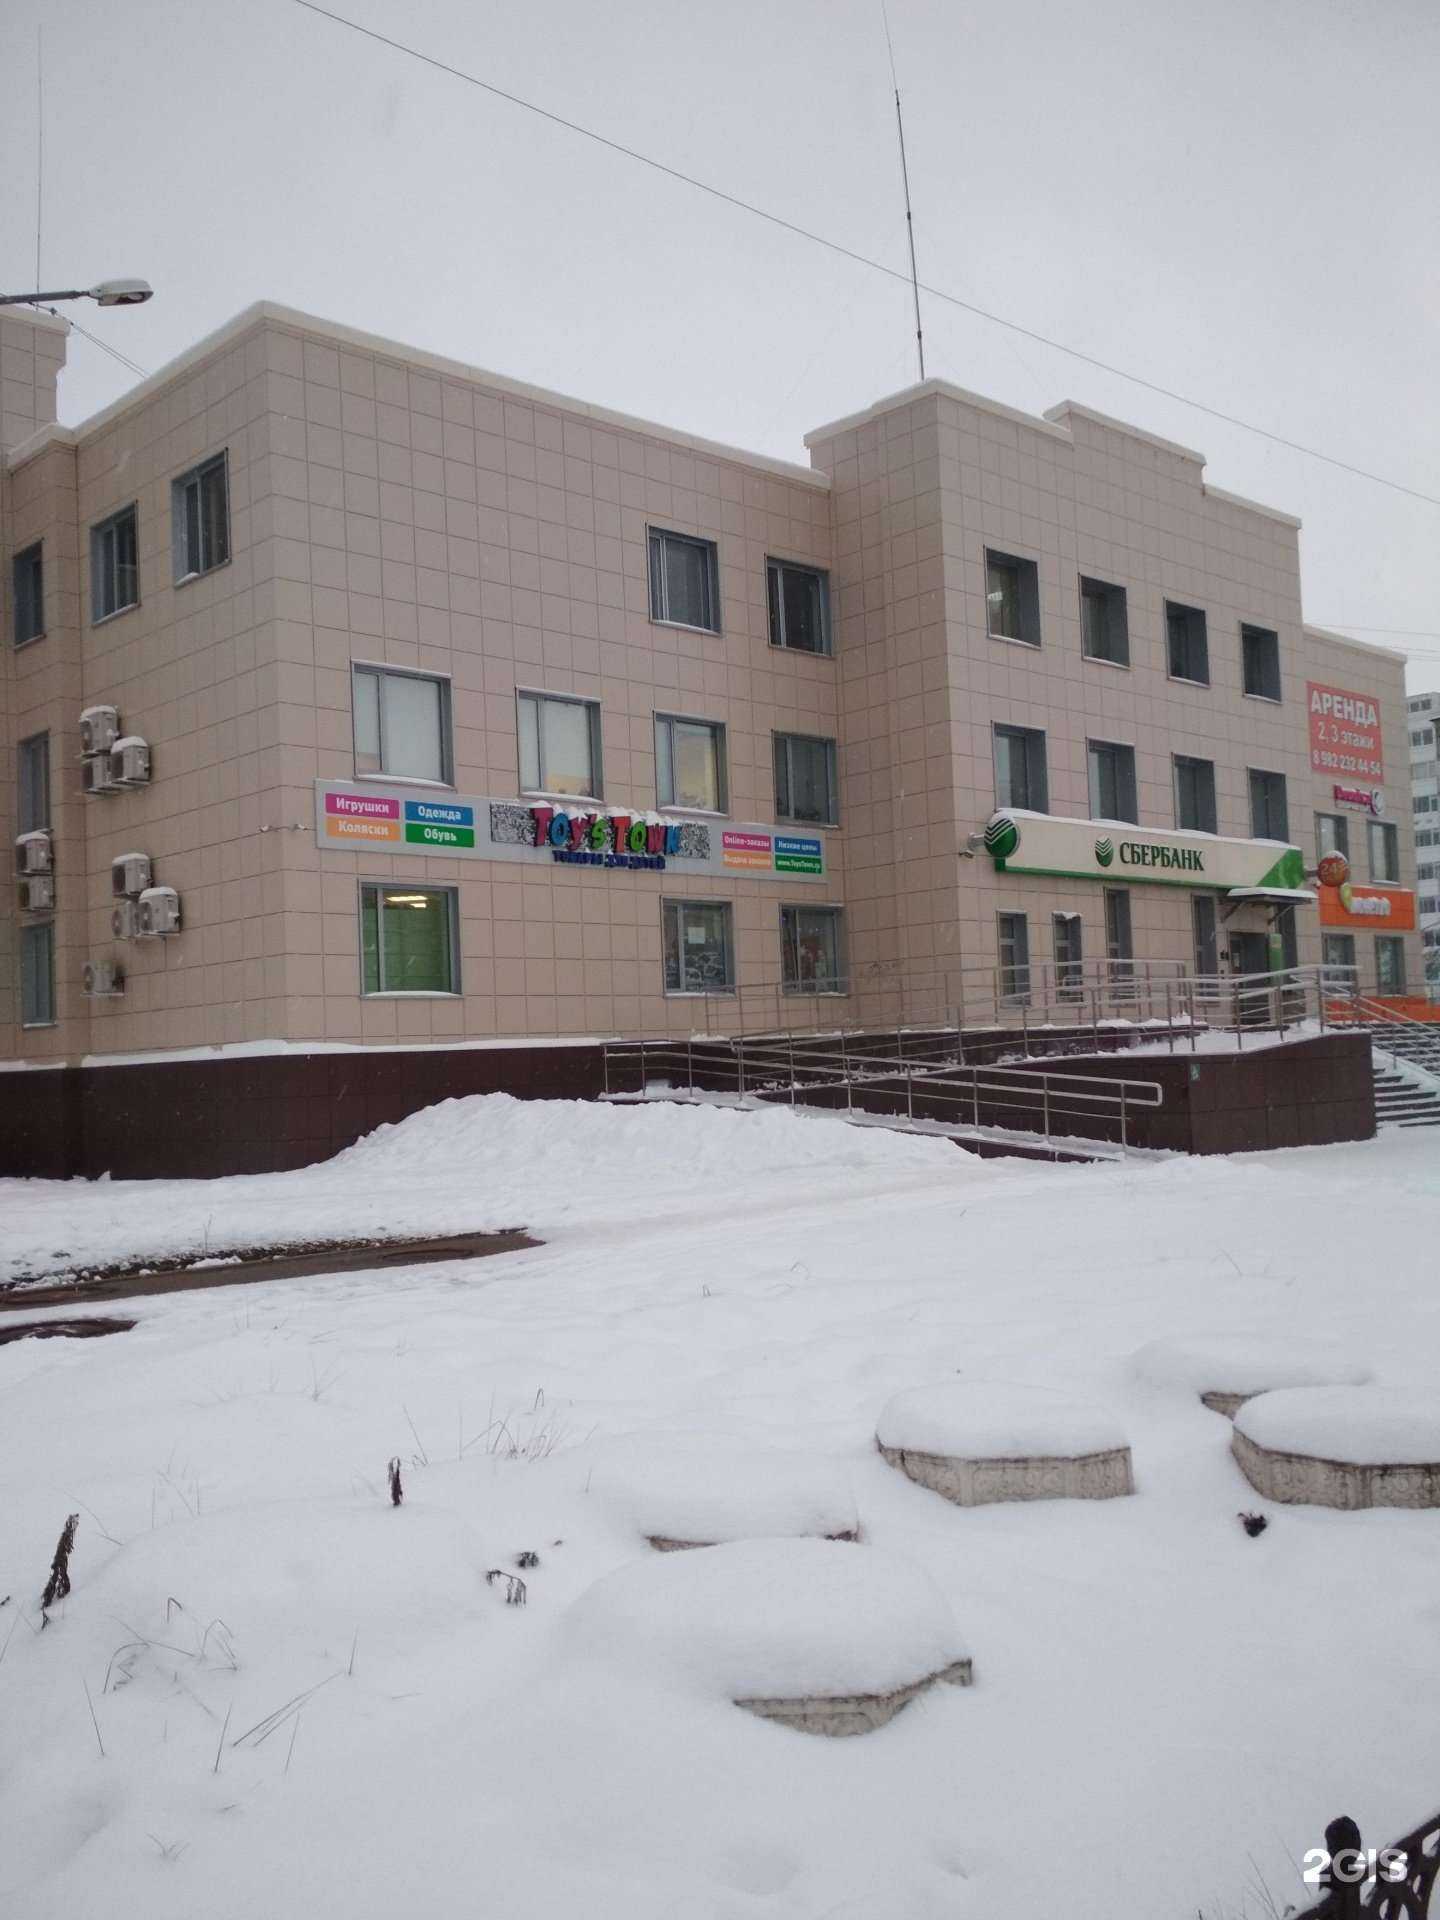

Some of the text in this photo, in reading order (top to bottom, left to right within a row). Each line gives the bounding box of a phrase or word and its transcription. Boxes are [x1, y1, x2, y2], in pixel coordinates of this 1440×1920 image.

[1311, 690, 1378, 728] АРЕНДА
[1331, 724, 1339, 742] 3
[1312, 750, 1320, 764] 8
[335, 797, 390, 814] Игрушки
[417, 805, 462, 821] Одежда
[338, 820, 389, 836] Коляски
[424, 828, 457, 843] Обувь
[1119, 842, 1204, 871] СБЕРБАНК
